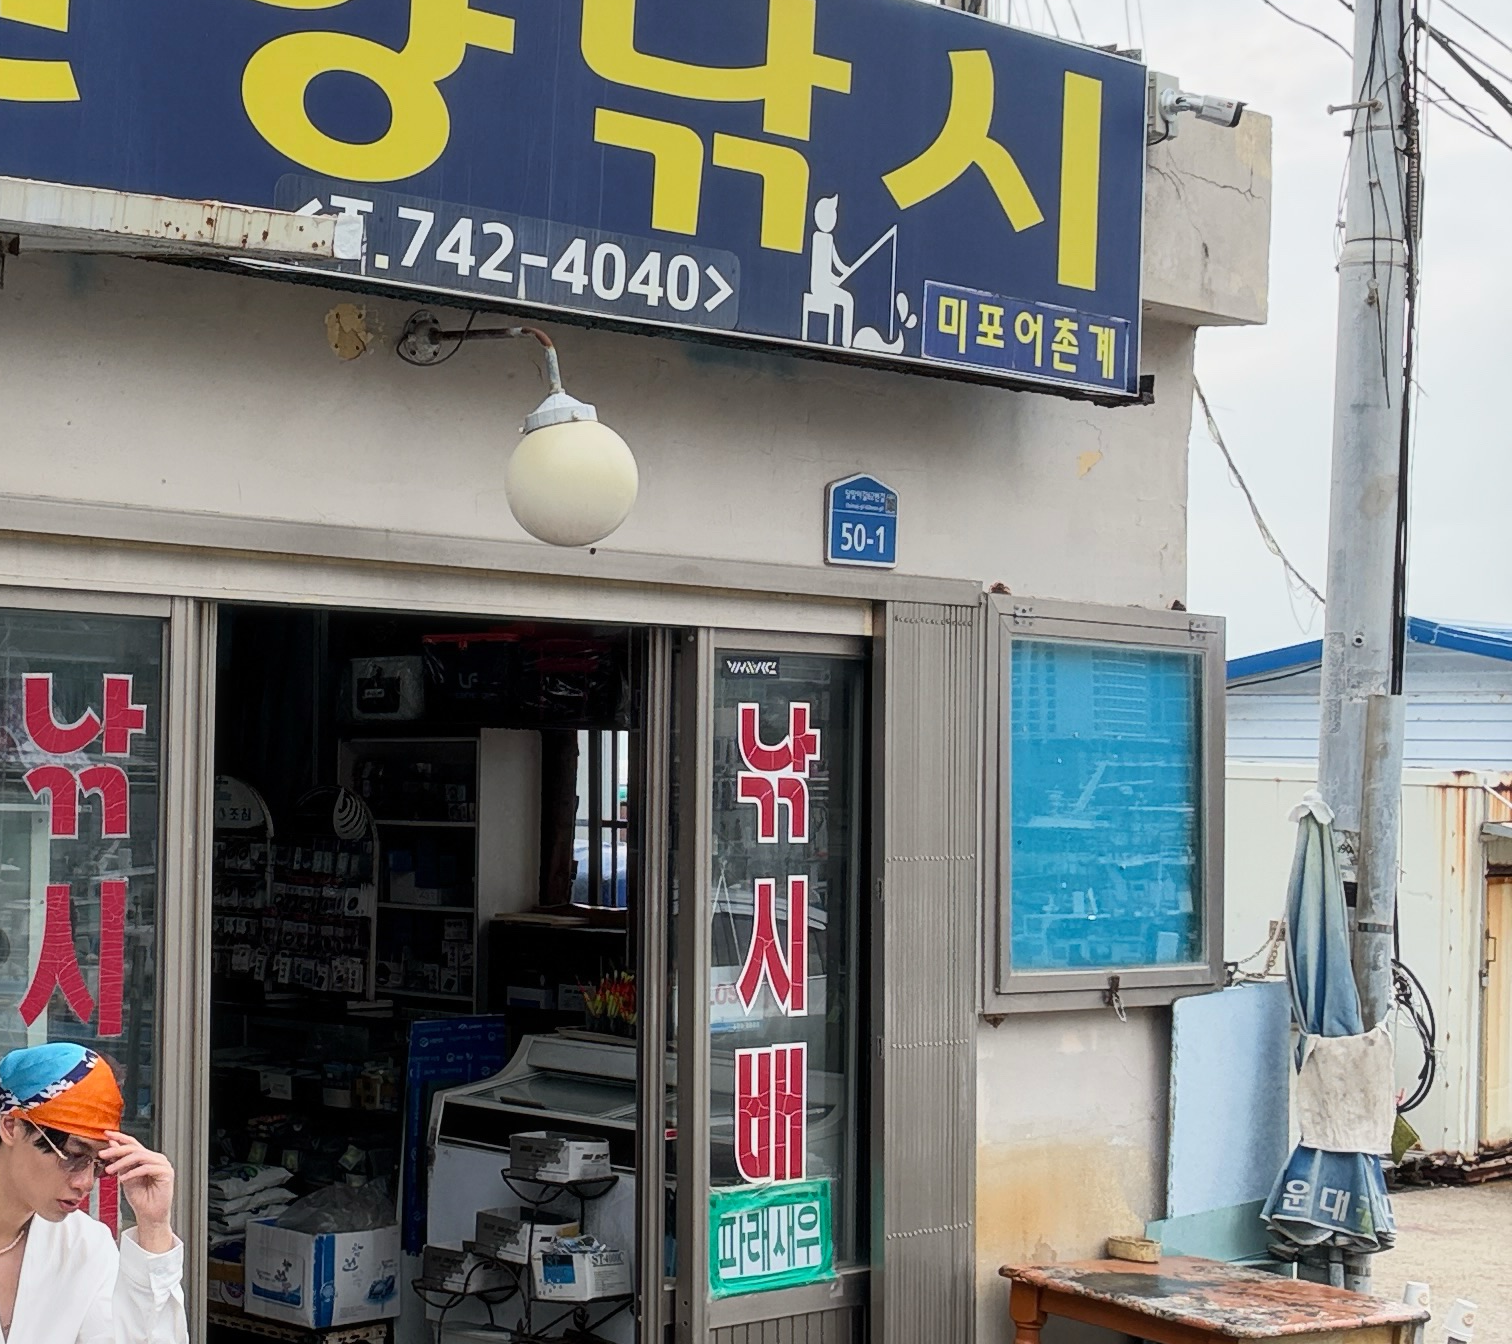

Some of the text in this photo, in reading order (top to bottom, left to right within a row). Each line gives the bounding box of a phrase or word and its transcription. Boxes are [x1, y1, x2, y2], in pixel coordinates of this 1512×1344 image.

[938, 296, 1116, 380] 미포어촌계
[840, 522, 886, 554] 50-1
[734, 701, 822, 1184] 낚시배
[719, 1205, 820, 1276] 파래새우
